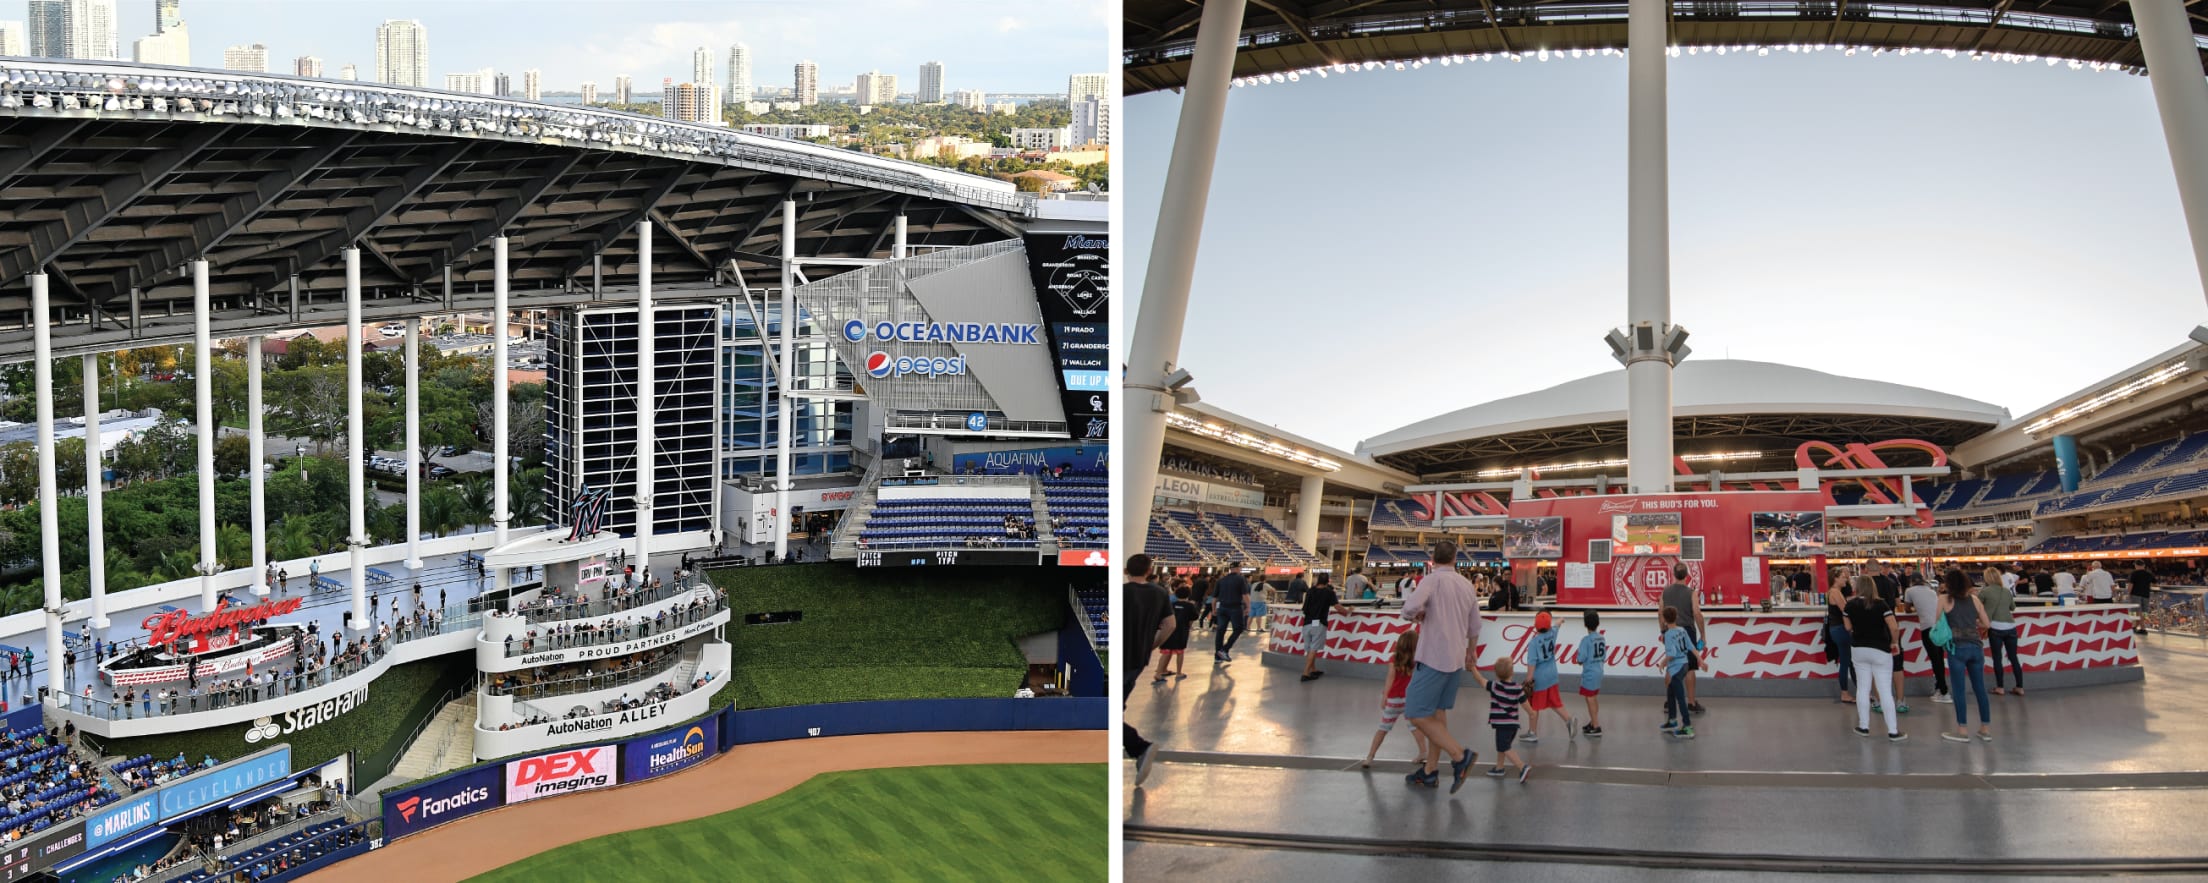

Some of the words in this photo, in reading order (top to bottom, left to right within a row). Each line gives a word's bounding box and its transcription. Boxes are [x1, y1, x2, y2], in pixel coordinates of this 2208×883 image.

[875, 322, 1039, 344] OCEANBANK
[895, 354, 966, 378] pepsi
[1070, 375, 1087, 386] DUE
[1090, 376, 1101, 386] UP
[968, 416, 985, 427] 42
[985, 451, 1046, 468] AQUAFINA
[1162, 478, 1200, 495] LEON
[1641, 500, 1658, 509] THIS
[1660, 500, 1682, 509] BUD'S
[1684, 500, 1699, 508] FOR
[1701, 499, 1718, 508] YOU.
[938, 557, 955, 565] TYPE
[142, 597, 303, 646] Budweiser
[579, 646, 620, 659] PROUD
[626, 633, 677, 652] PARTNERS
[1540, 639, 1556, 660] 14
[1593, 641, 1605, 658] 16
[521, 652, 565, 664] AutoNation
[547, 716, 613, 736] AutoNation
[619, 703, 667, 725] ALLEY
[650, 742, 704, 768] HealthSun
[515, 748, 600, 786] DEX
[163, 759, 287, 813] CLEVELANDER
[534, 774, 608, 794] imaging
[422, 787, 489, 818] Fanatics
[105, 801, 150, 836] MARLINS
[46, 833, 83, 855] CHALLENGES
[369, 838, 384, 850] 382
